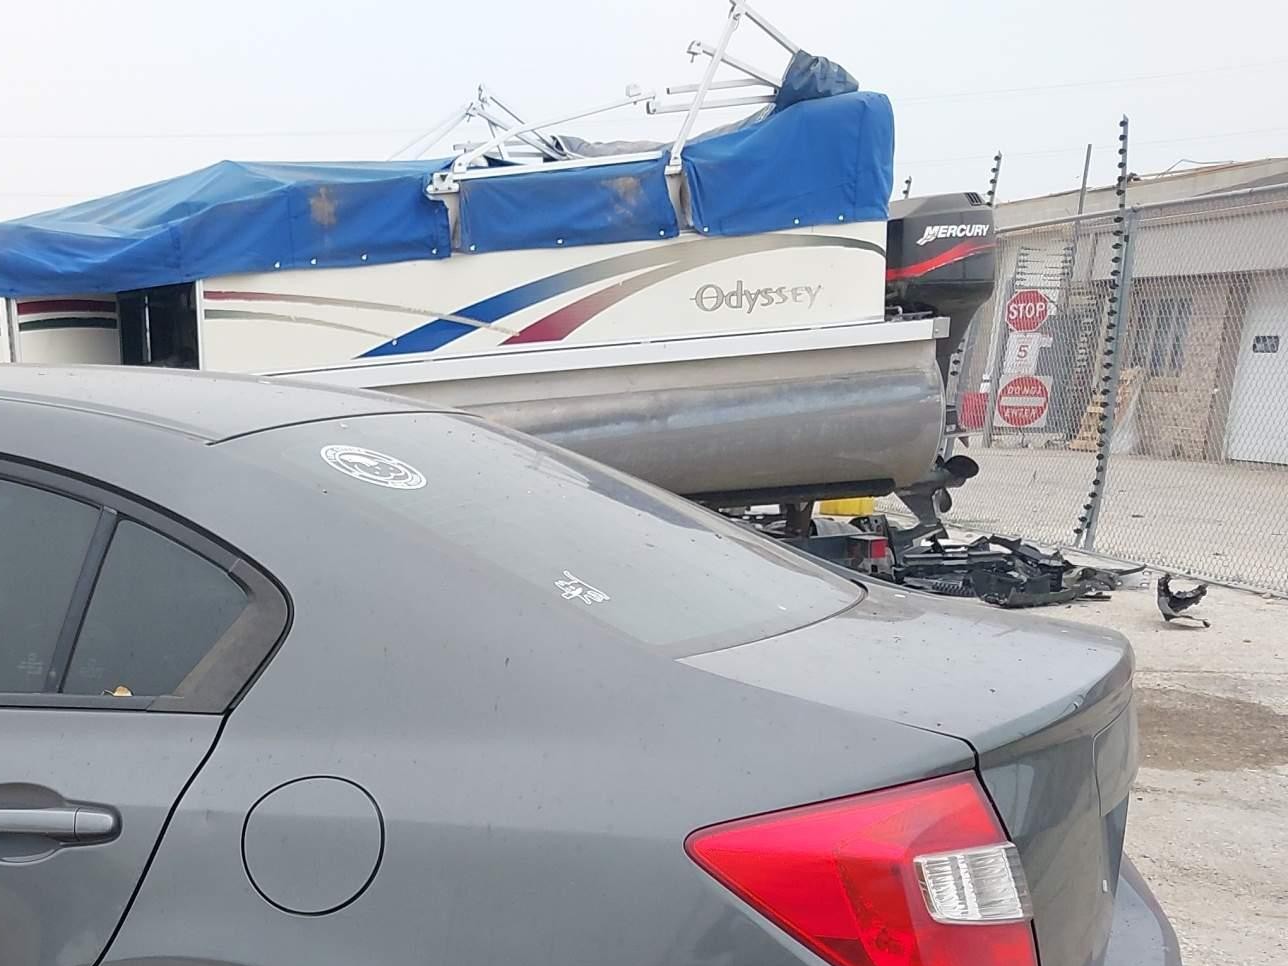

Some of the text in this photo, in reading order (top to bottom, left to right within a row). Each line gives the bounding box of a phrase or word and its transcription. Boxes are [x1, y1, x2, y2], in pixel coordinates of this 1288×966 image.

[916, 224, 990, 246] MERCURY
[1009, 303, 1045, 319] STOP
[1017, 345, 1029, 358] 5
